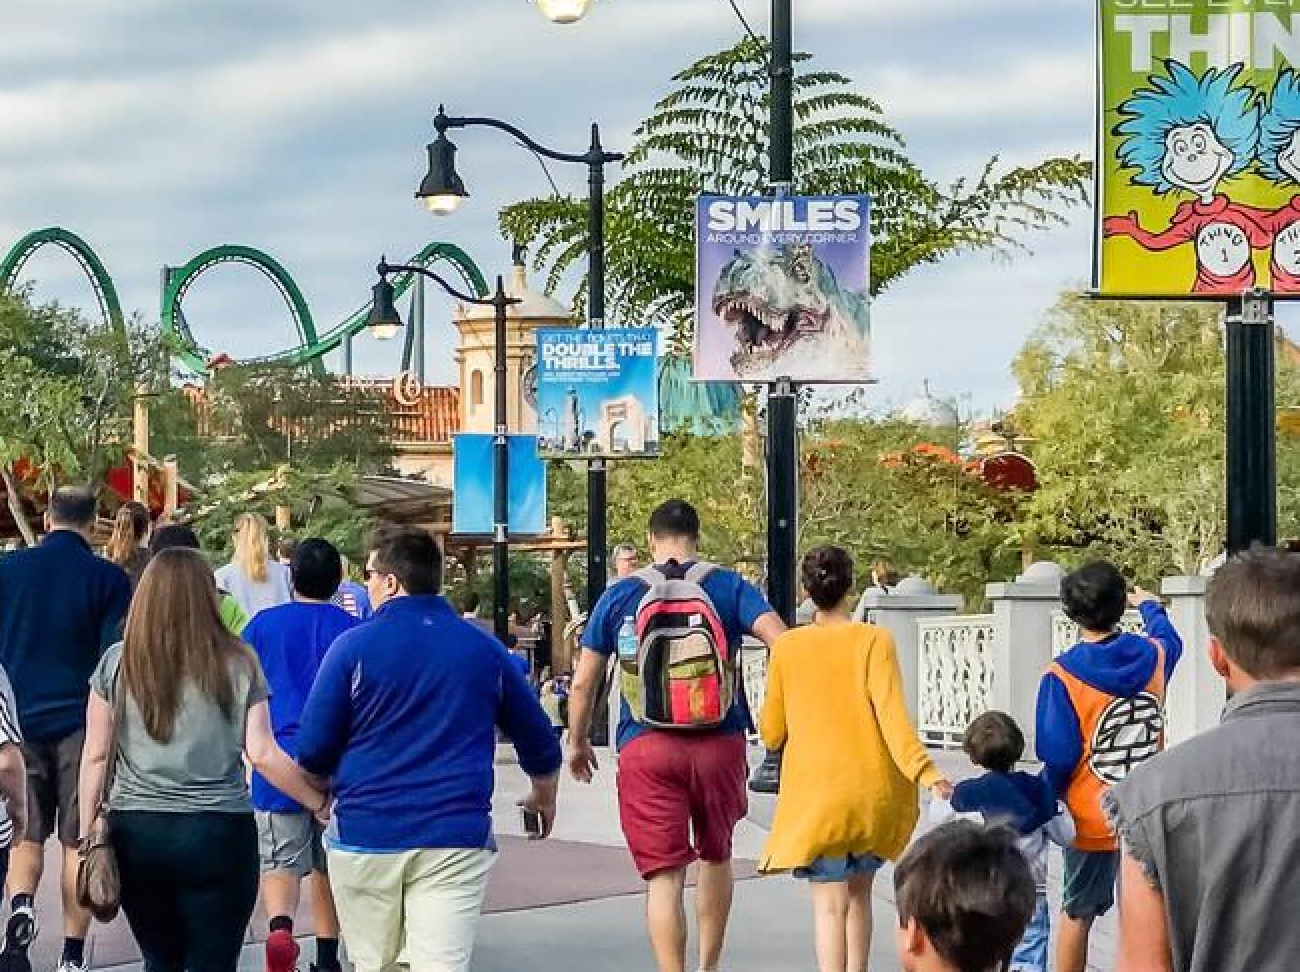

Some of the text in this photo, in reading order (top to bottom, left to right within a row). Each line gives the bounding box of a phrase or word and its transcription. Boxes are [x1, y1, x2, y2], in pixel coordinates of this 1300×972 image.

[708, 201, 861, 230] SMILES
[706, 234, 760, 243] AROUND
[1200, 227, 1243, 246] THING
[1222, 248, 1229, 263] 1
[543, 343, 653, 357] DOUBLE THE
